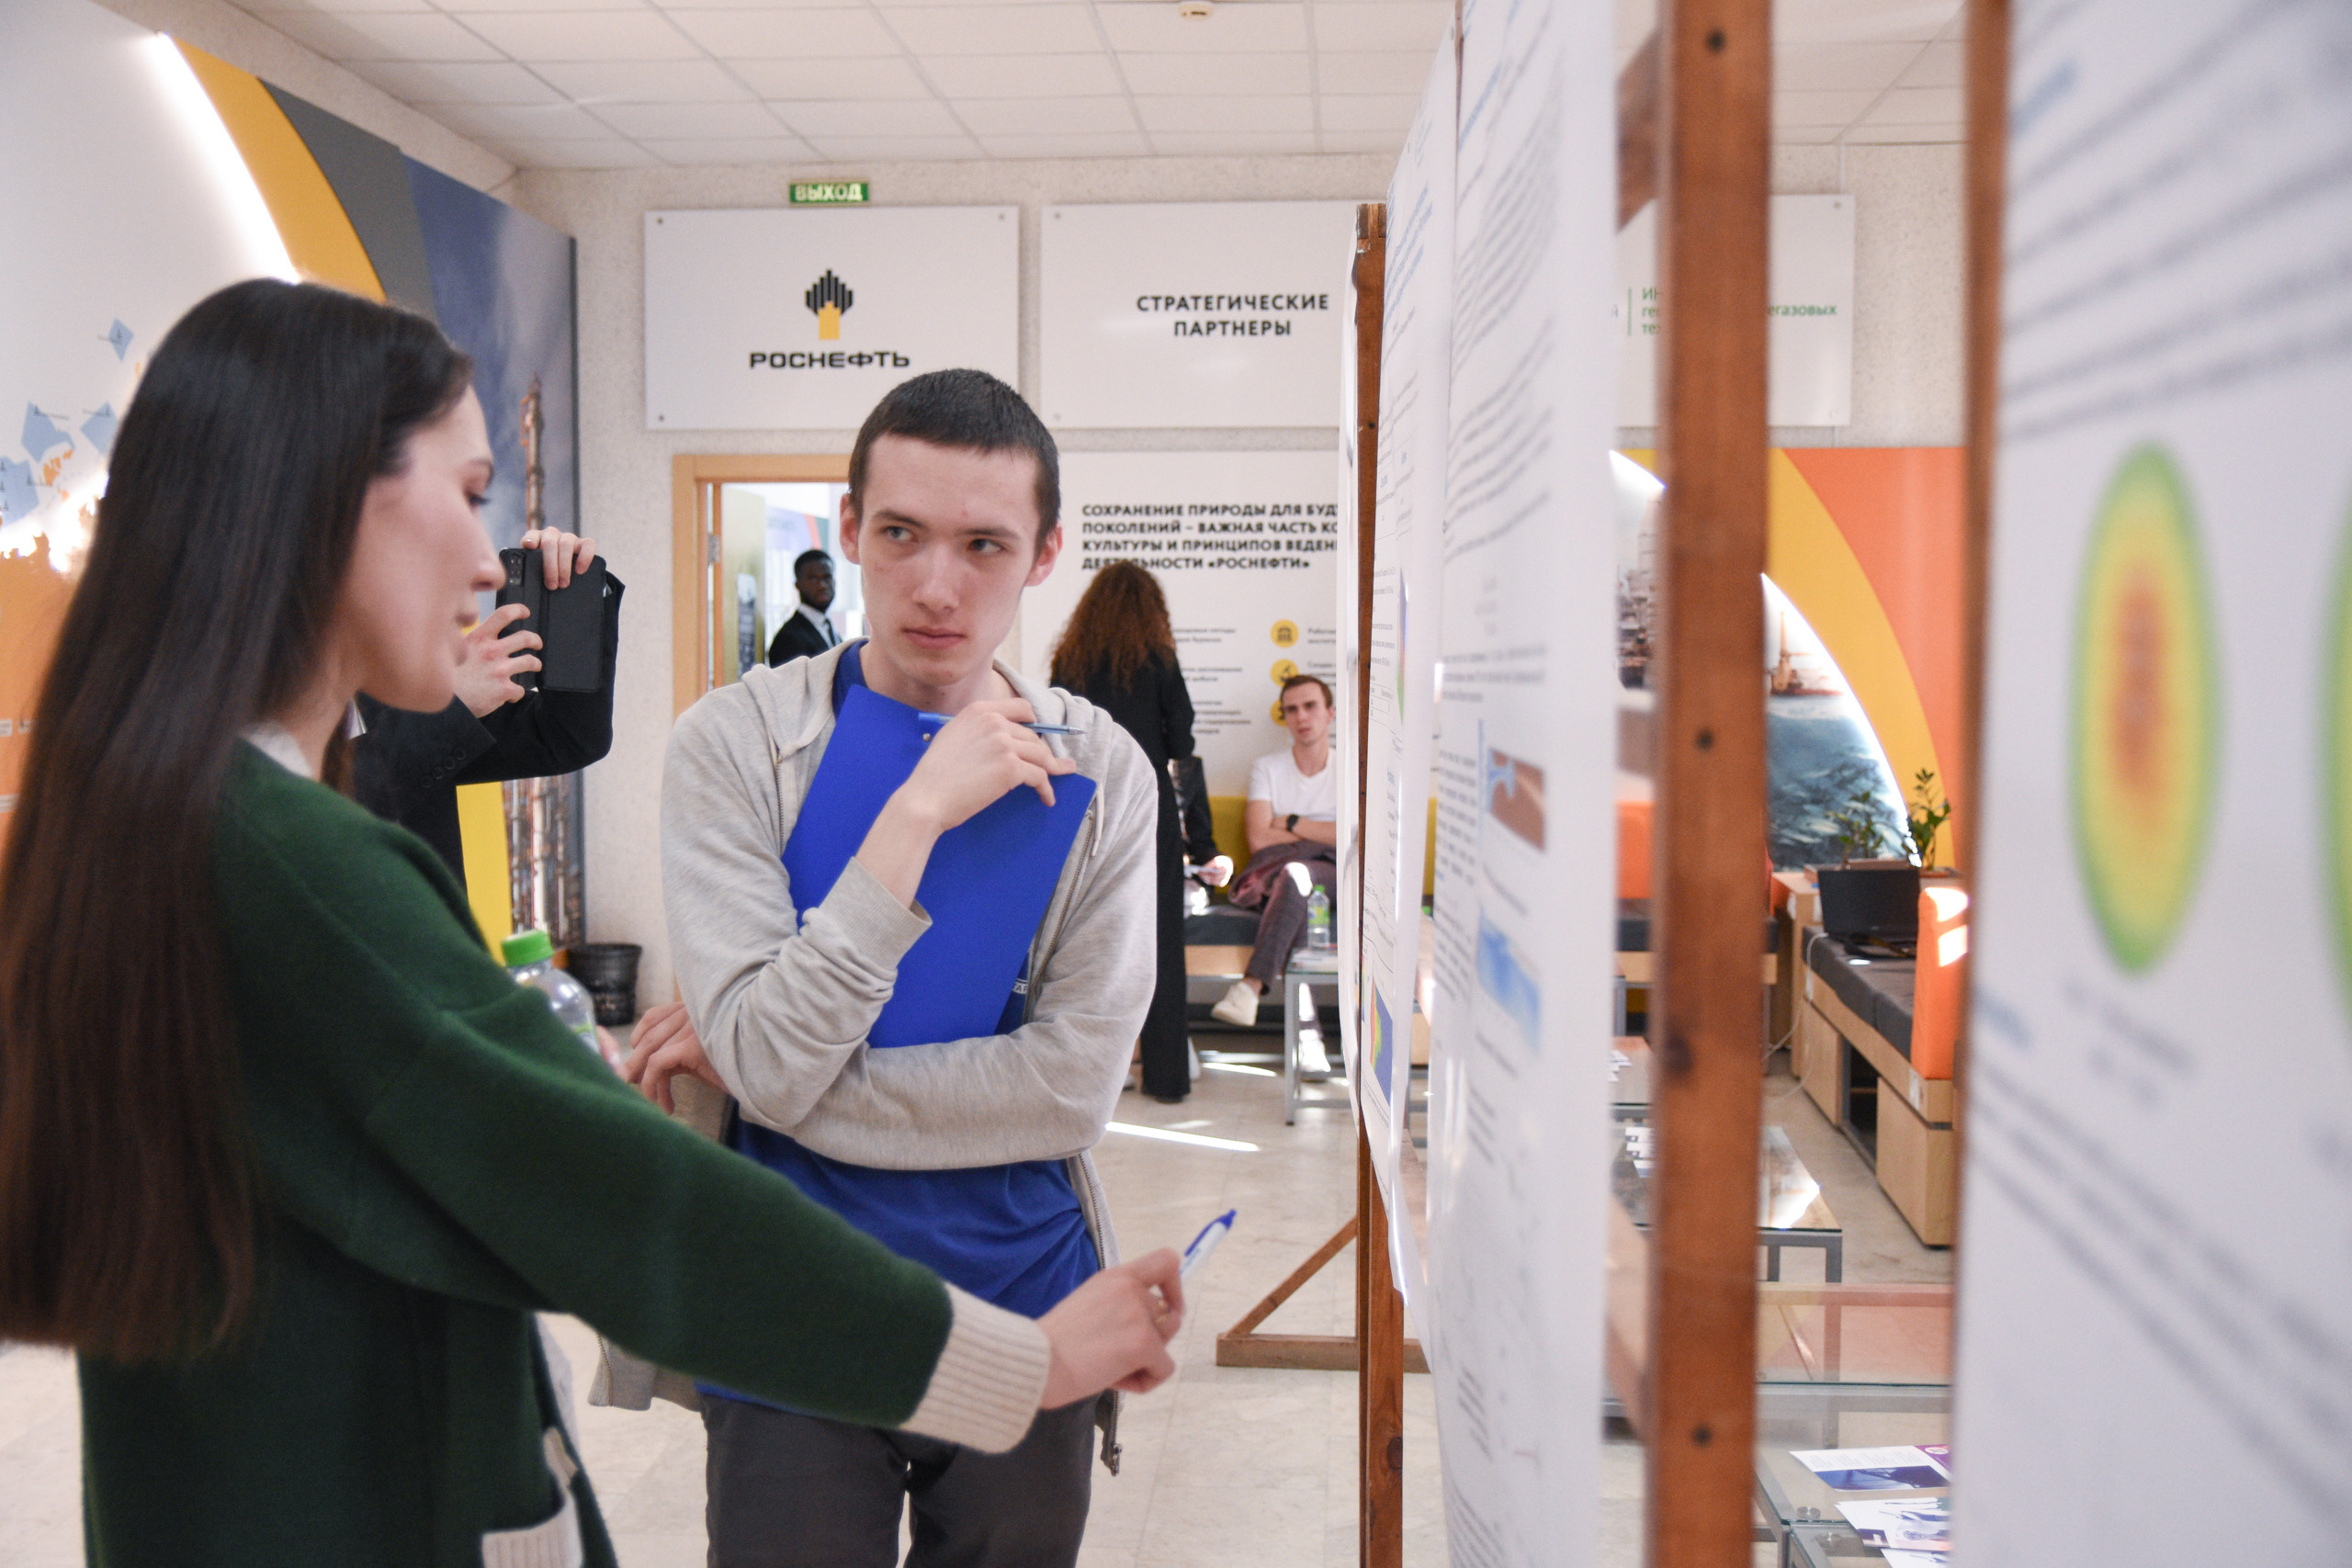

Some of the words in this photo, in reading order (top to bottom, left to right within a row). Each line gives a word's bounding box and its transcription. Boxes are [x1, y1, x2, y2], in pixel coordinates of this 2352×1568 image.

[794, 183, 864, 202] ВЫХОД
[1136, 294, 1329, 310] СТРАТЕГИЧЕСКИЕ
[1174, 321, 1291, 336] ПАРТНЕРЫ
[750, 352, 910, 368] РОСНЕФТЬ
[1082, 504, 1184, 516] СОХРАНЕНИЕ
[1188, 504, 1266, 516] ПРИРОДЫ
[1270, 504, 1302, 517] ДЛЯ
[1082, 519, 1181, 534] ПОКОЛЕНИЙ
[1198, 522, 1263, 534] ВАЖНАЯ
[1268, 522, 1317, 534] ЧАСТЬ
[1082, 539, 1162, 551] КУЛЬТУРЫ
[1167, 539, 1178, 551] И
[1182, 539, 1282, 553] ПРИНЦИПОВ
[1286, 539, 1338, 553] ВЕДЕН
[1208, 557, 1310, 569] «РОСНЕФТИ»
